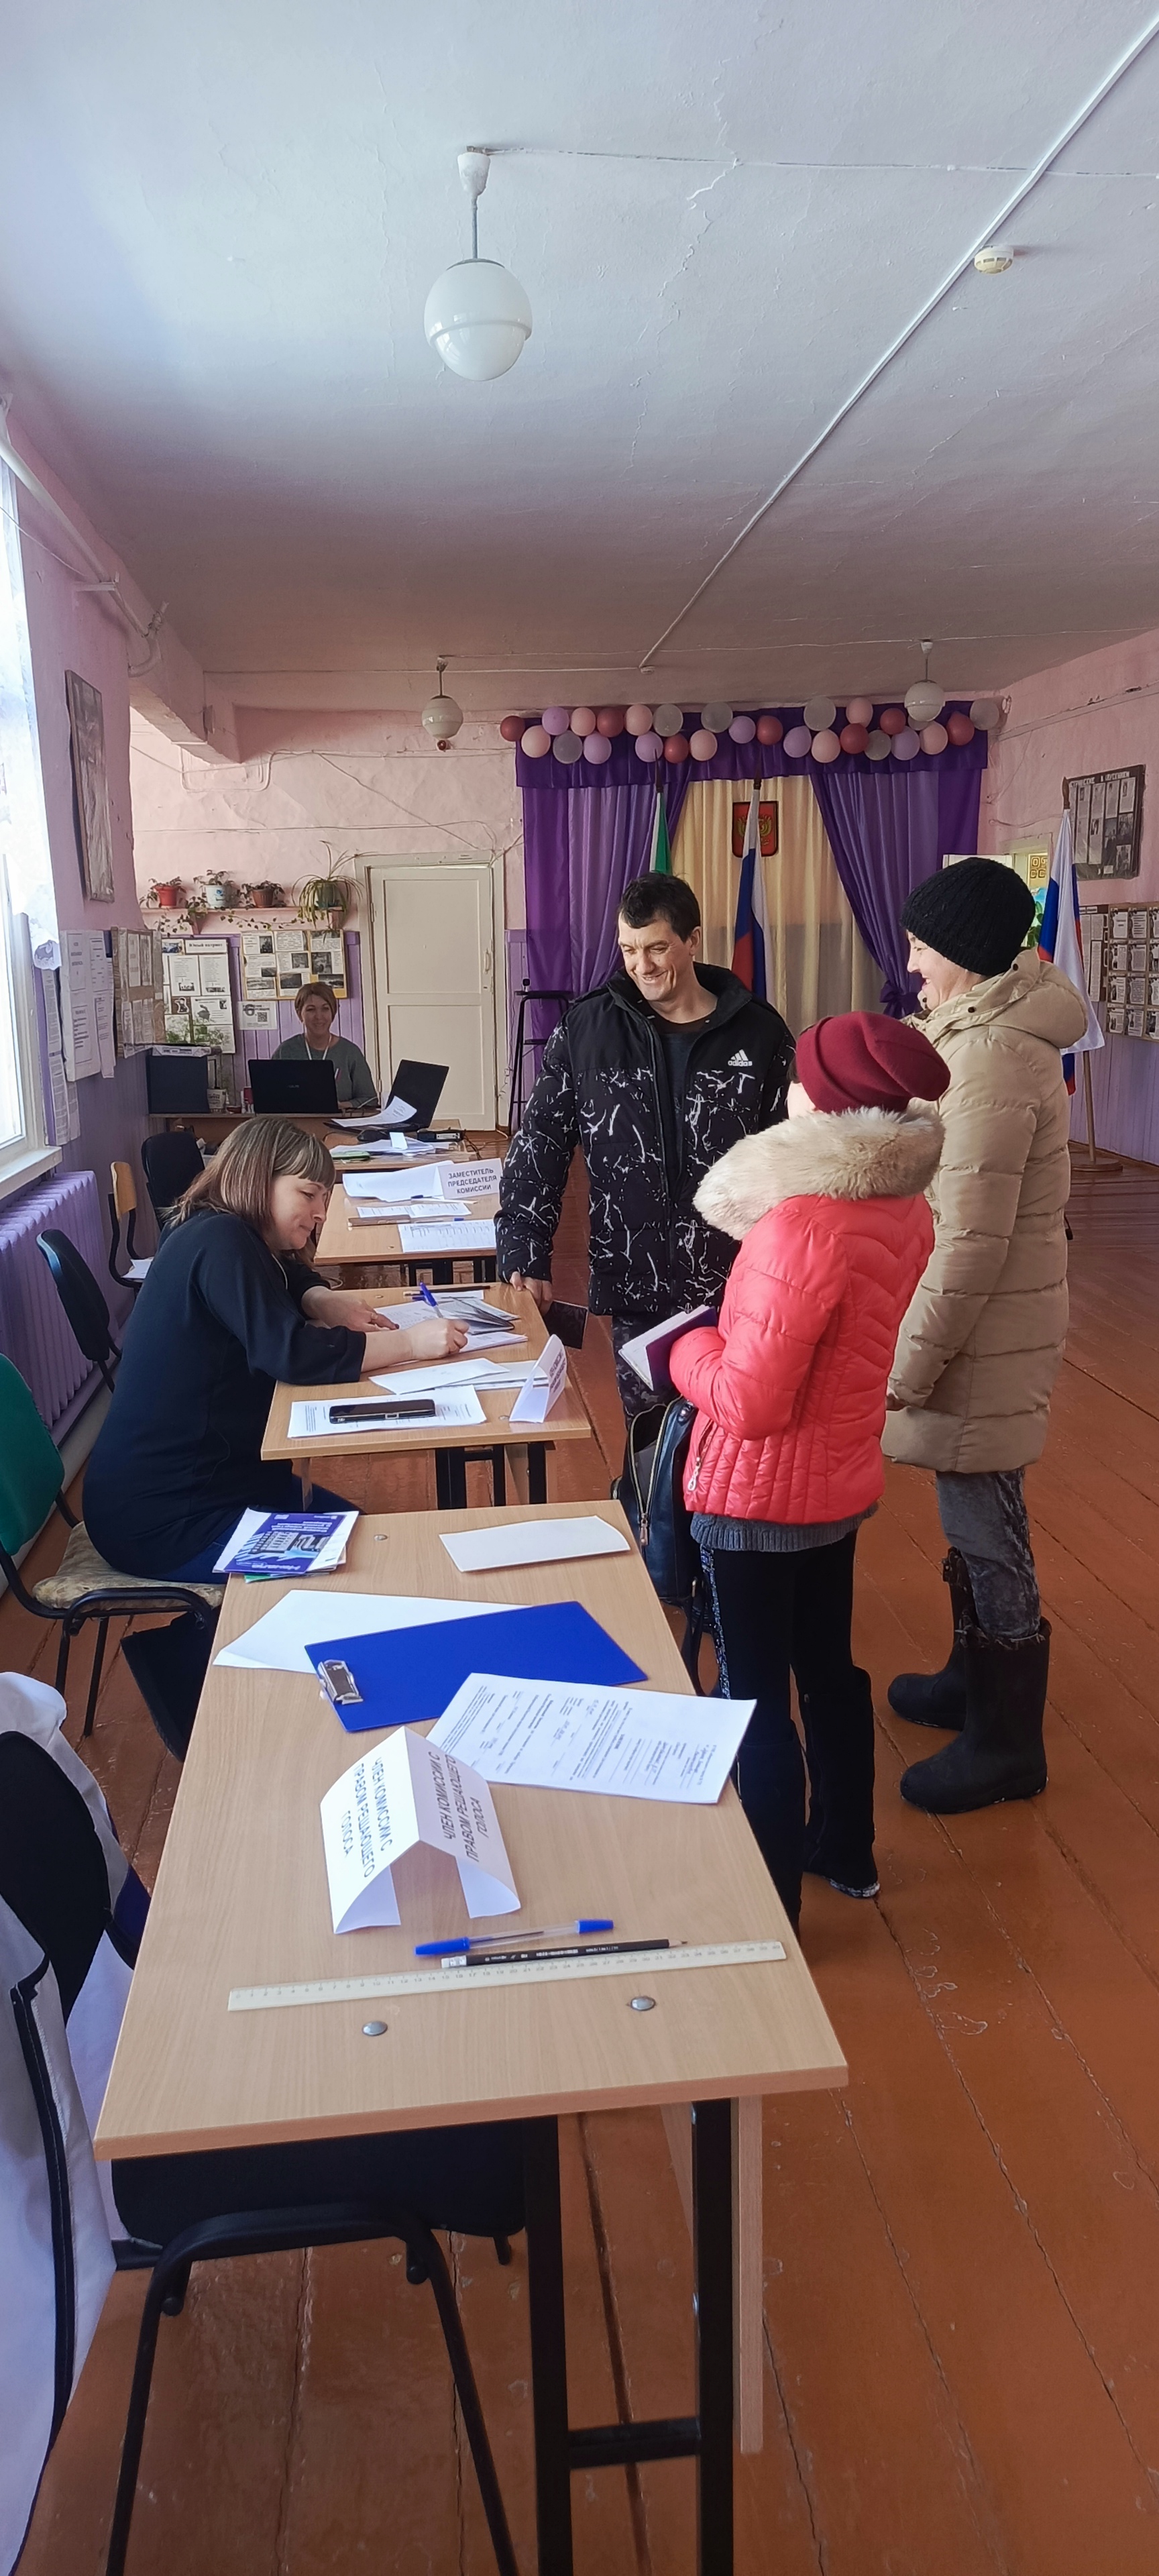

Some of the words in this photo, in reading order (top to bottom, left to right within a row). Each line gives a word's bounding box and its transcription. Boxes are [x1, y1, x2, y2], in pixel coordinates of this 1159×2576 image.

[448, 1167, 494, 1179] ЗАМЕСТИТЕЛЬ
[448, 1175, 497, 1187] ПРЕДСЕДАТЕЛЯ
[456, 1185, 491, 1194] КОМИССИИ
[353, 1763, 369, 1805] ПРАВОМ
[372, 1756, 382, 1783] ЧЛЕН
[431, 1760, 451, 1815] КОМИССИИ
[445, 1754, 468, 1819] РЕШАЮЩЕГО
[374, 1783, 392, 1841] КОМИССИИ
[441, 1813, 453, 1839] ЧЛЕН
[470, 1796, 489, 1838] ГОЛОСА
[341, 1811, 353, 1857] ГОЛОСА
[357, 1805, 376, 1878] РЕШАЮЩЕГО
[461, 1818, 480, 1862] ПРАВОМ
